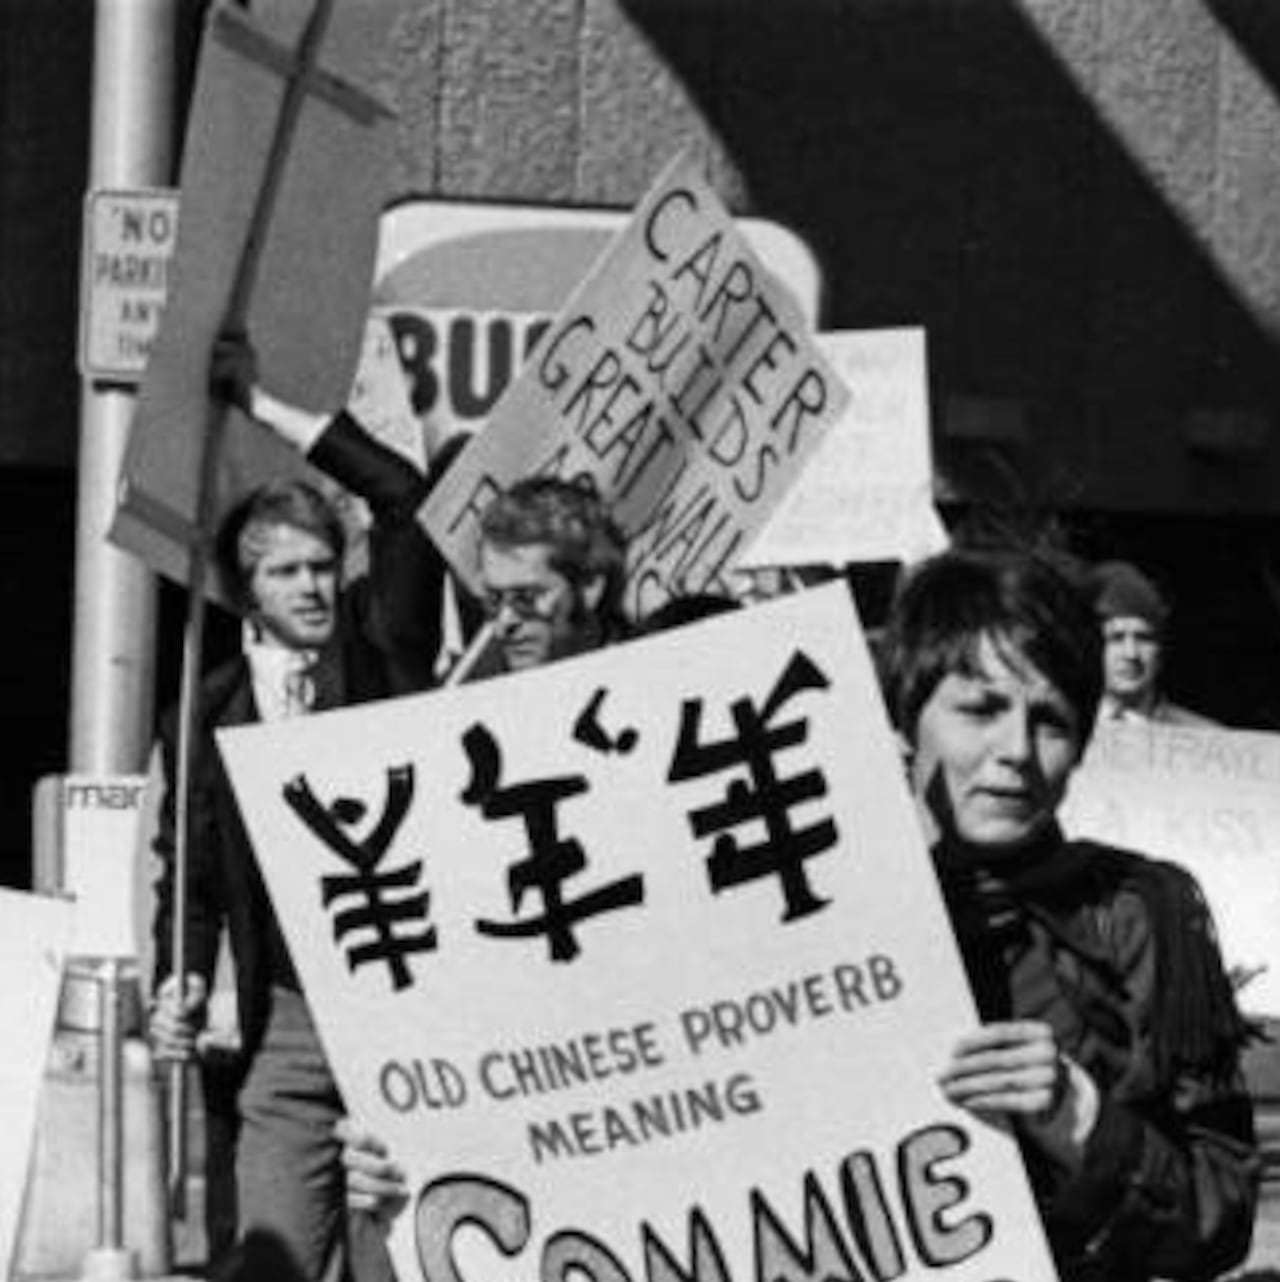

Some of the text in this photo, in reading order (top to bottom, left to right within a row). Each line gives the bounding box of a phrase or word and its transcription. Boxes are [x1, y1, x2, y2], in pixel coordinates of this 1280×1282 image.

[122, 209, 170, 243] NO
[626, 280, 778, 502] BUILDS
[644, 188, 828, 454] CARTER
[539, 315, 674, 498] GREAT
[379, 955, 902, 1113] OLD CHINESE PROVERB
[528, 1074, 762, 1163] MEANING
